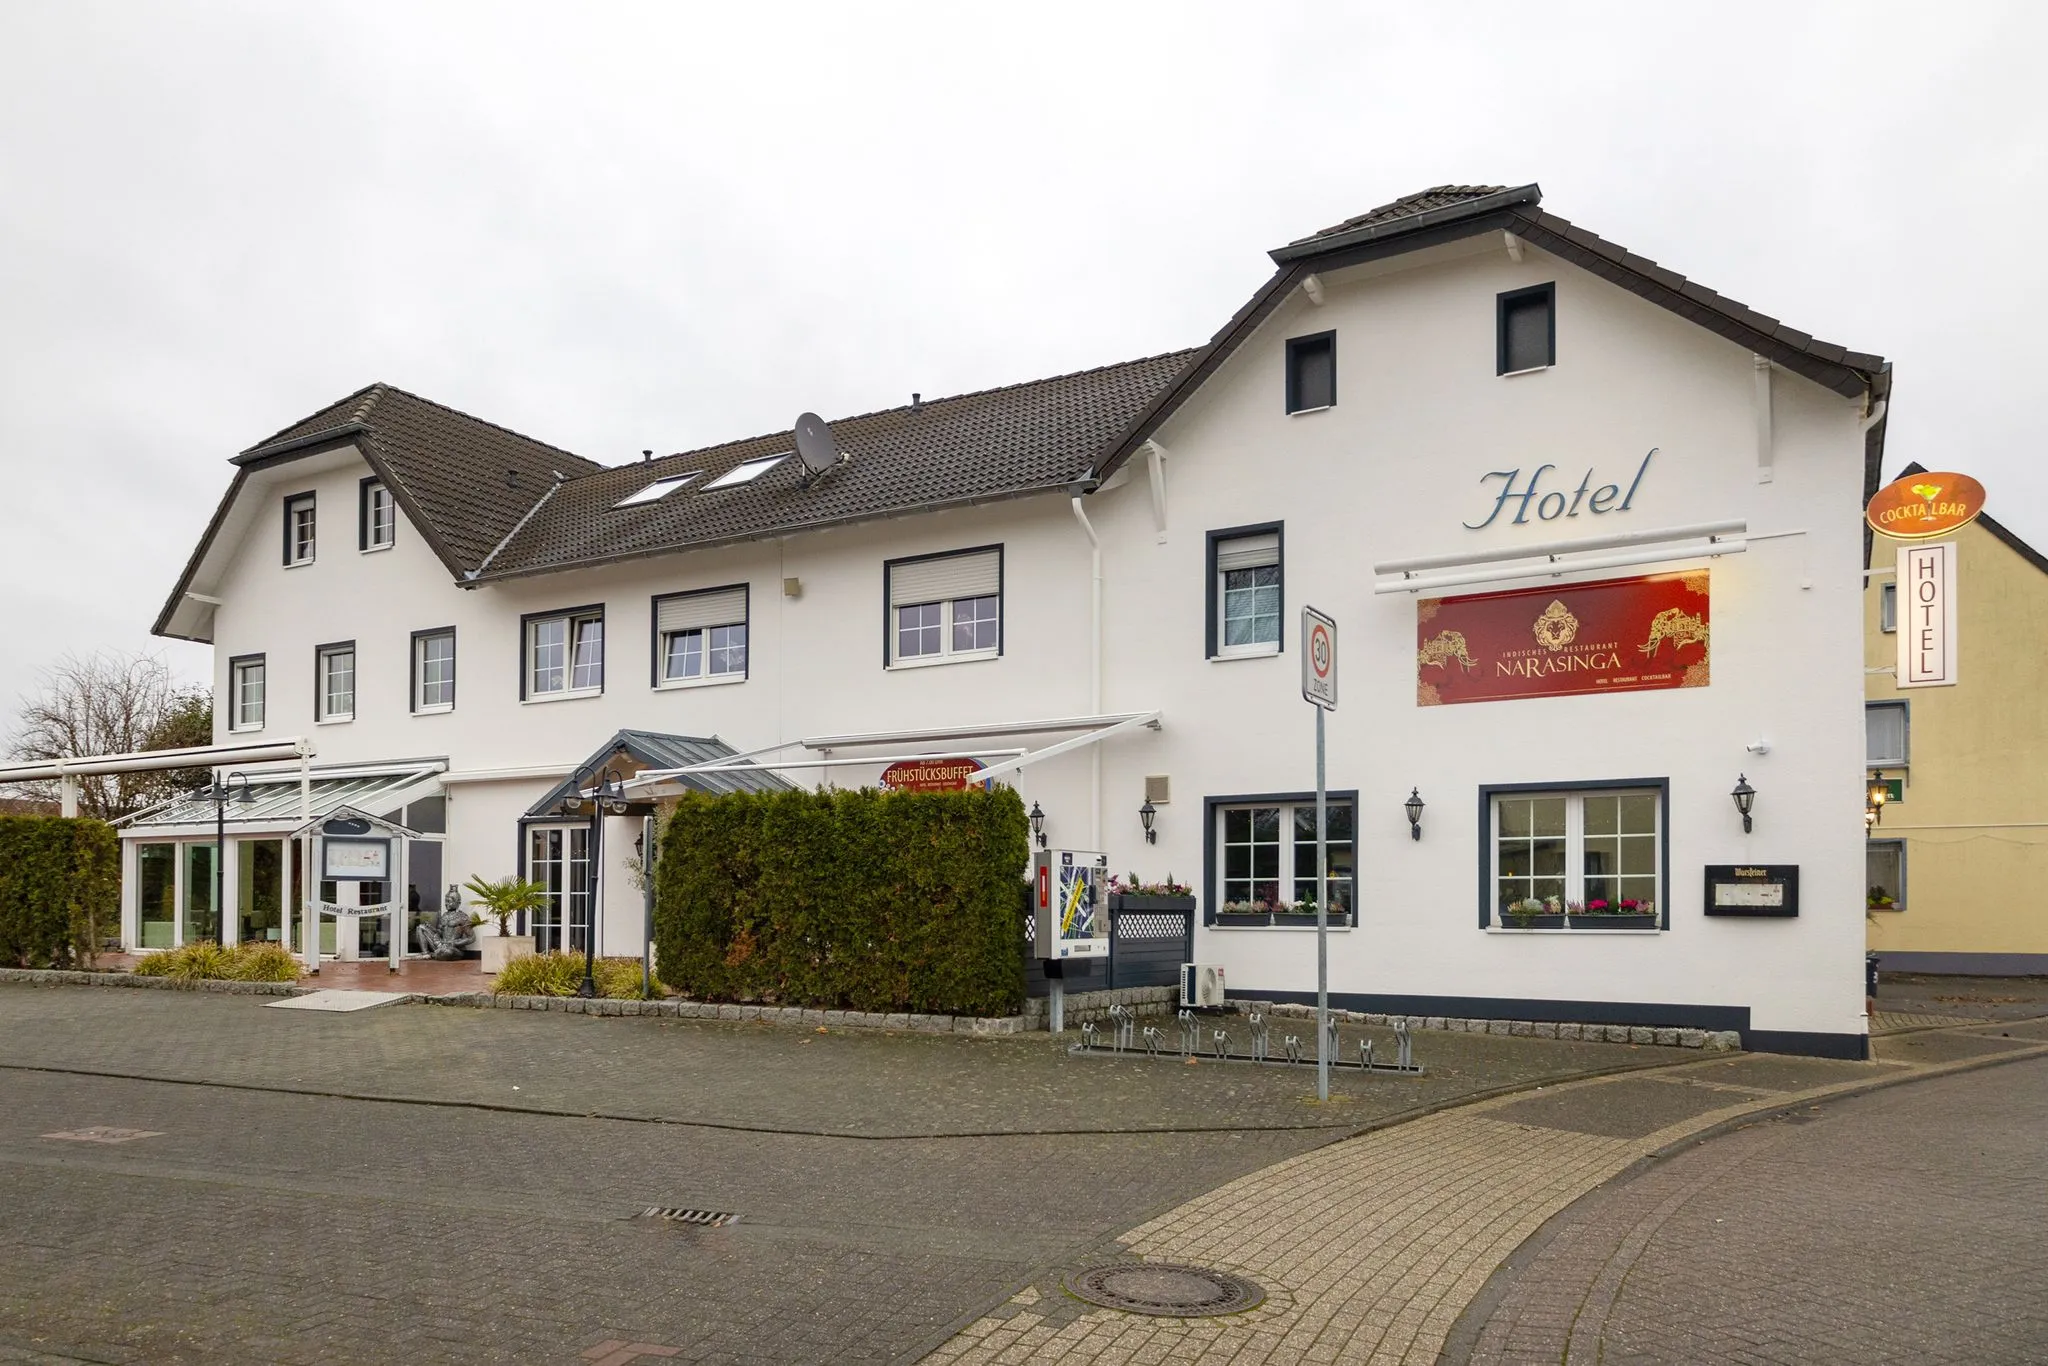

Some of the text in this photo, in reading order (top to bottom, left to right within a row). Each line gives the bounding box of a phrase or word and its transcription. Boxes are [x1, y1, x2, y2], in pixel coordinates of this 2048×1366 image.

[1462, 447, 1660, 530] Hotel
[1918, 556, 1936, 674] HOTEL
[1315, 638, 1327, 664] 30
[1502, 641, 1619, 658] INDISCHES RESTAURANT
[1496, 652, 1622, 678] NARASINGA
[1314, 678, 1328, 696] ZONE
[887, 766, 974, 782] FRÜHSTÜCKSBUFFET
[322, 904, 388, 915] Hotel Restaurant
